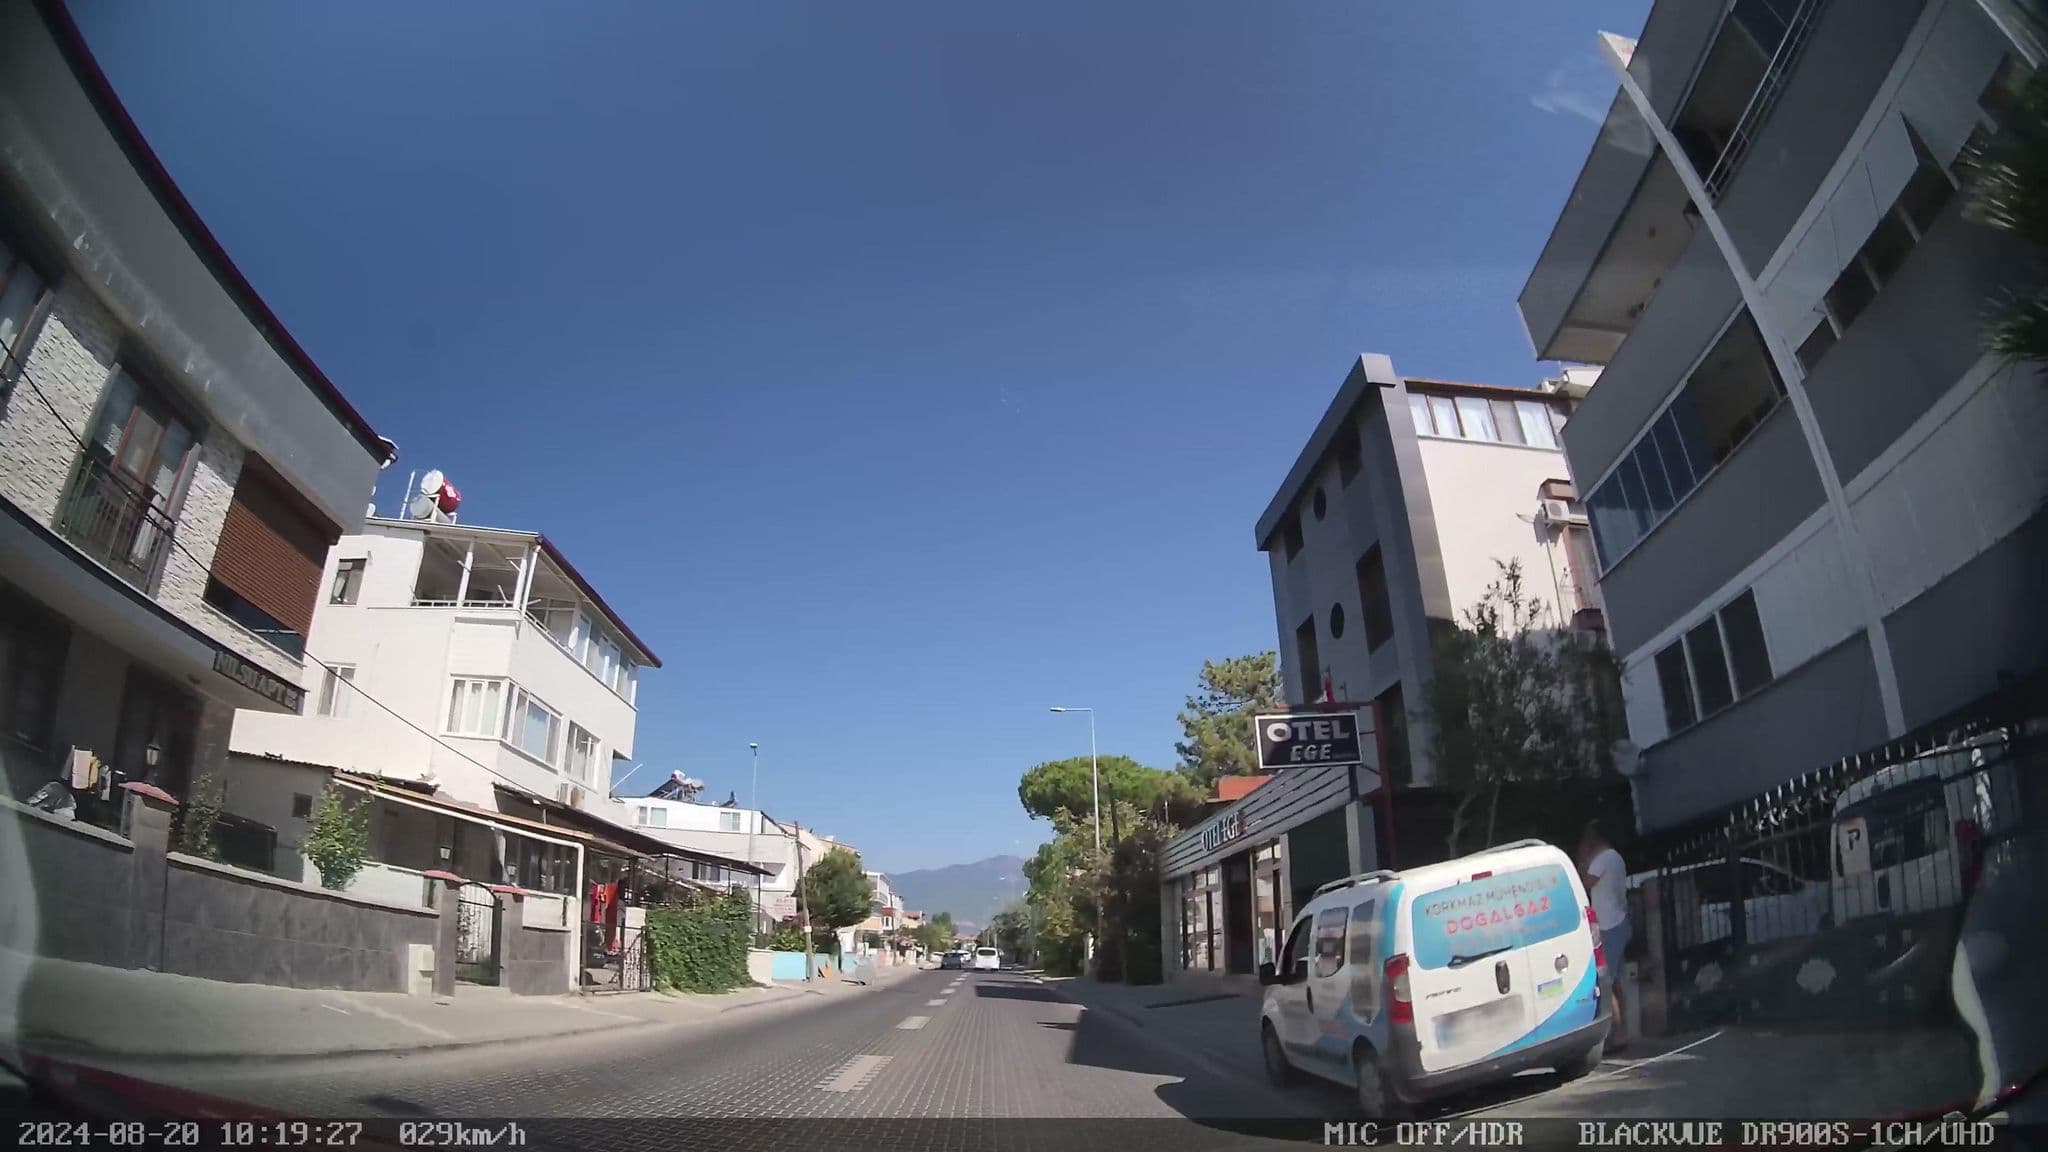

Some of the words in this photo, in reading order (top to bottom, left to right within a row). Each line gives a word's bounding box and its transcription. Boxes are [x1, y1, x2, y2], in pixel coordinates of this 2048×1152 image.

[1266, 719, 1350, 742] OTEL
[1290, 743, 1332, 761] EGE
[1201, 821, 1221, 851] OTEL
[1221, 811, 1240, 842] EGE
[1424, 893, 1483, 917] KORKMAZ
